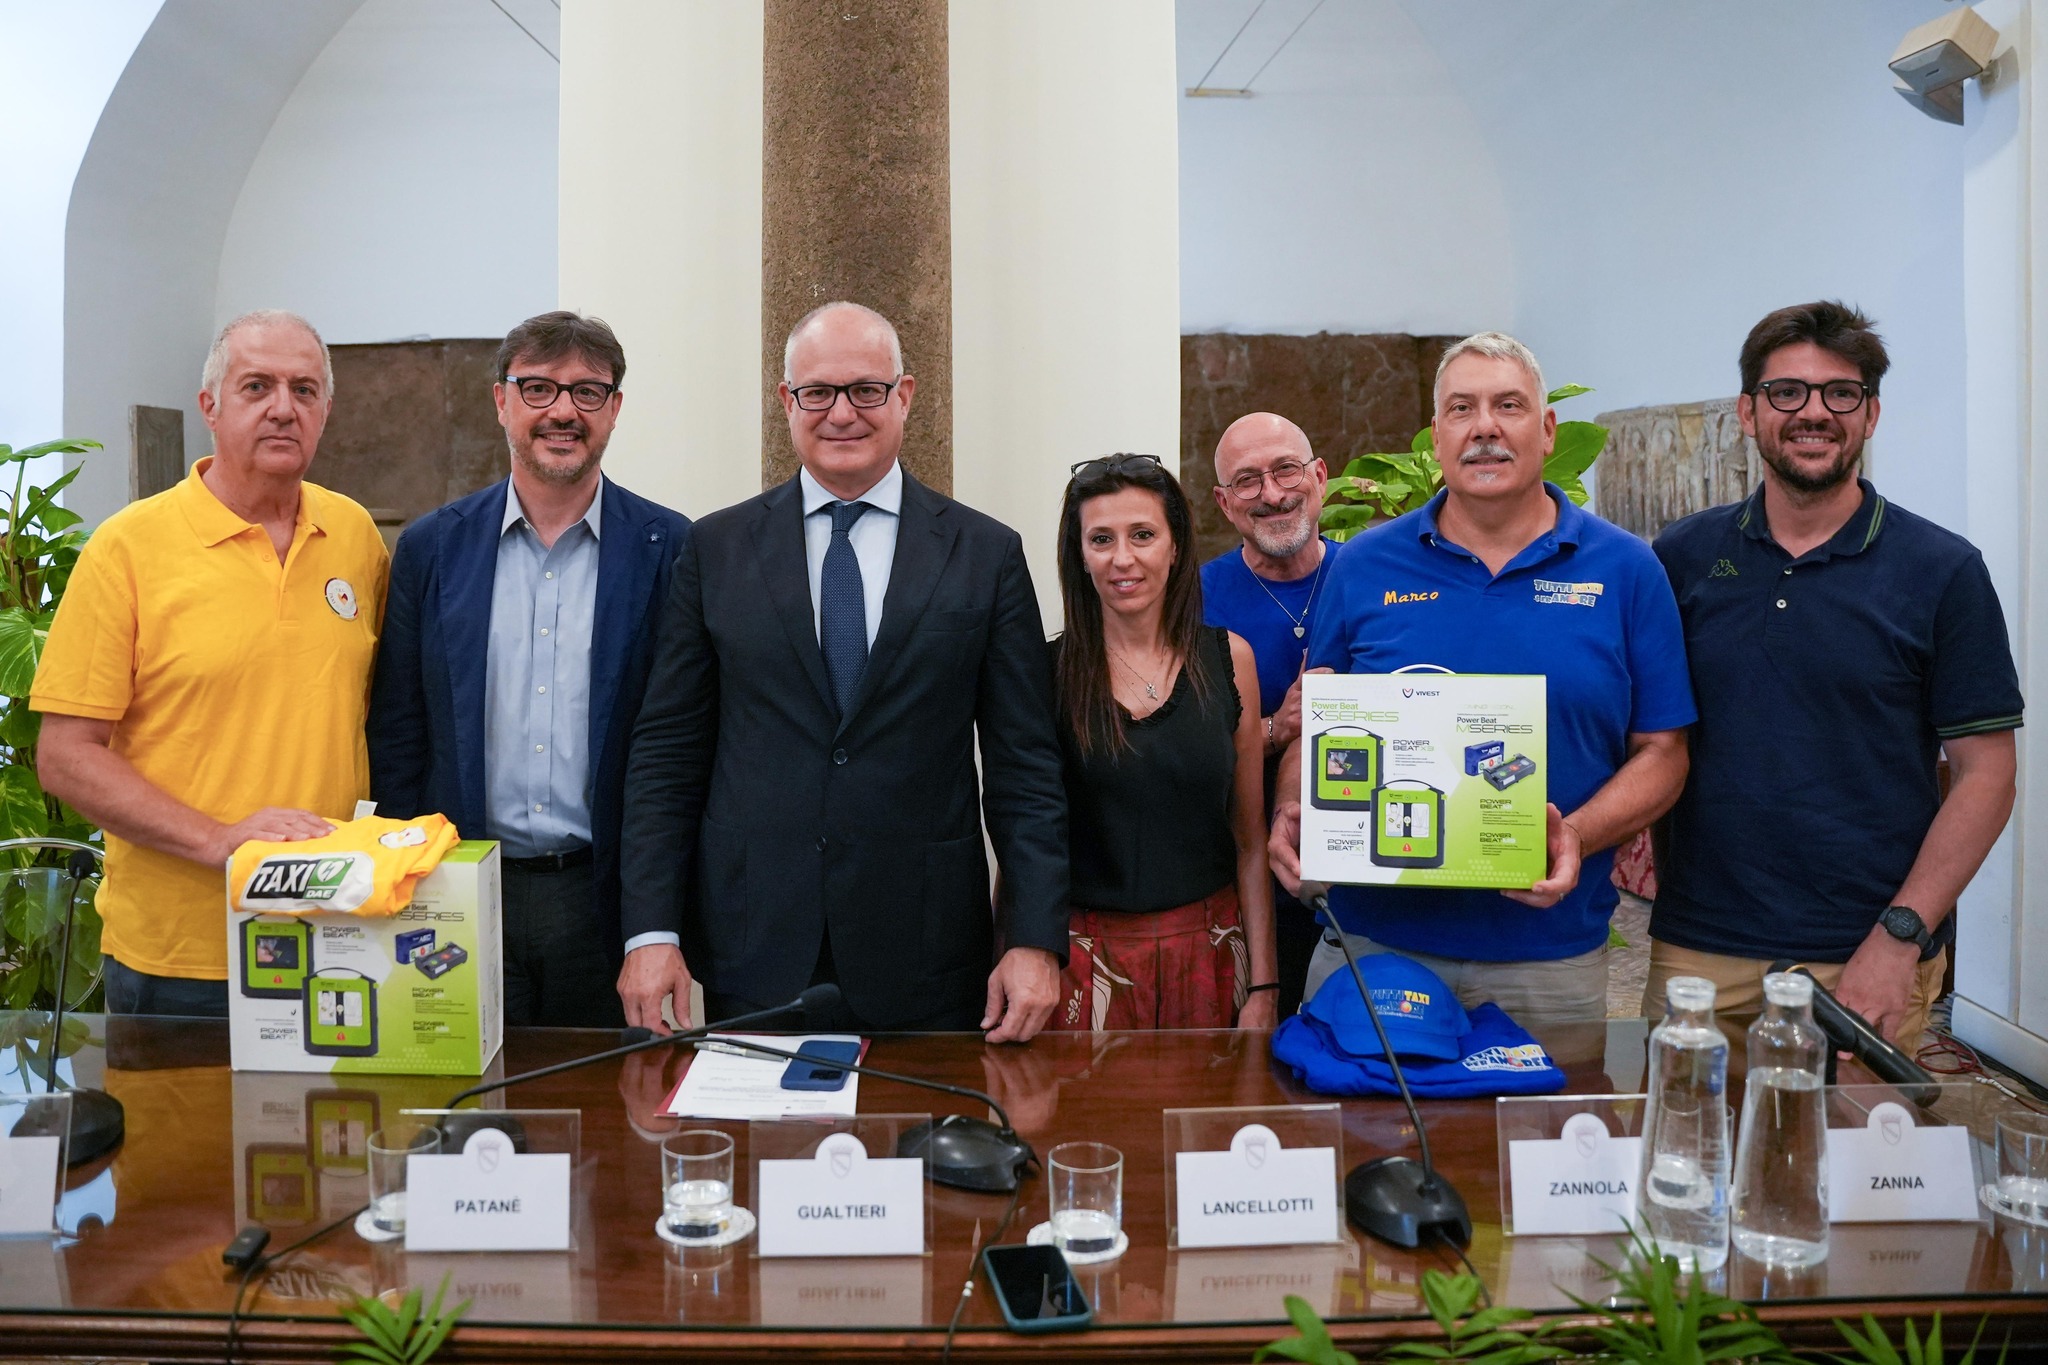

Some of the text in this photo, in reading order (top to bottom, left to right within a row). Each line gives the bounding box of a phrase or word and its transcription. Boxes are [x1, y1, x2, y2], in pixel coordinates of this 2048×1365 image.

[1383, 591, 1439, 606] Marco
[1311, 702, 1338, 710] Power
[1456, 716, 1480, 724] Power
[253, 863, 316, 893] TAXI
[306, 890, 334, 898] DAE
[1404, 991, 1430, 1005] TAXI
[1549, 1181, 1629, 1196] ZANNOLA
[1870, 1176, 1925, 1190] ZANNA
[797, 1204, 887, 1219] GUALTIERI
[1203, 1198, 1314, 1215] LANCELLOTTI
